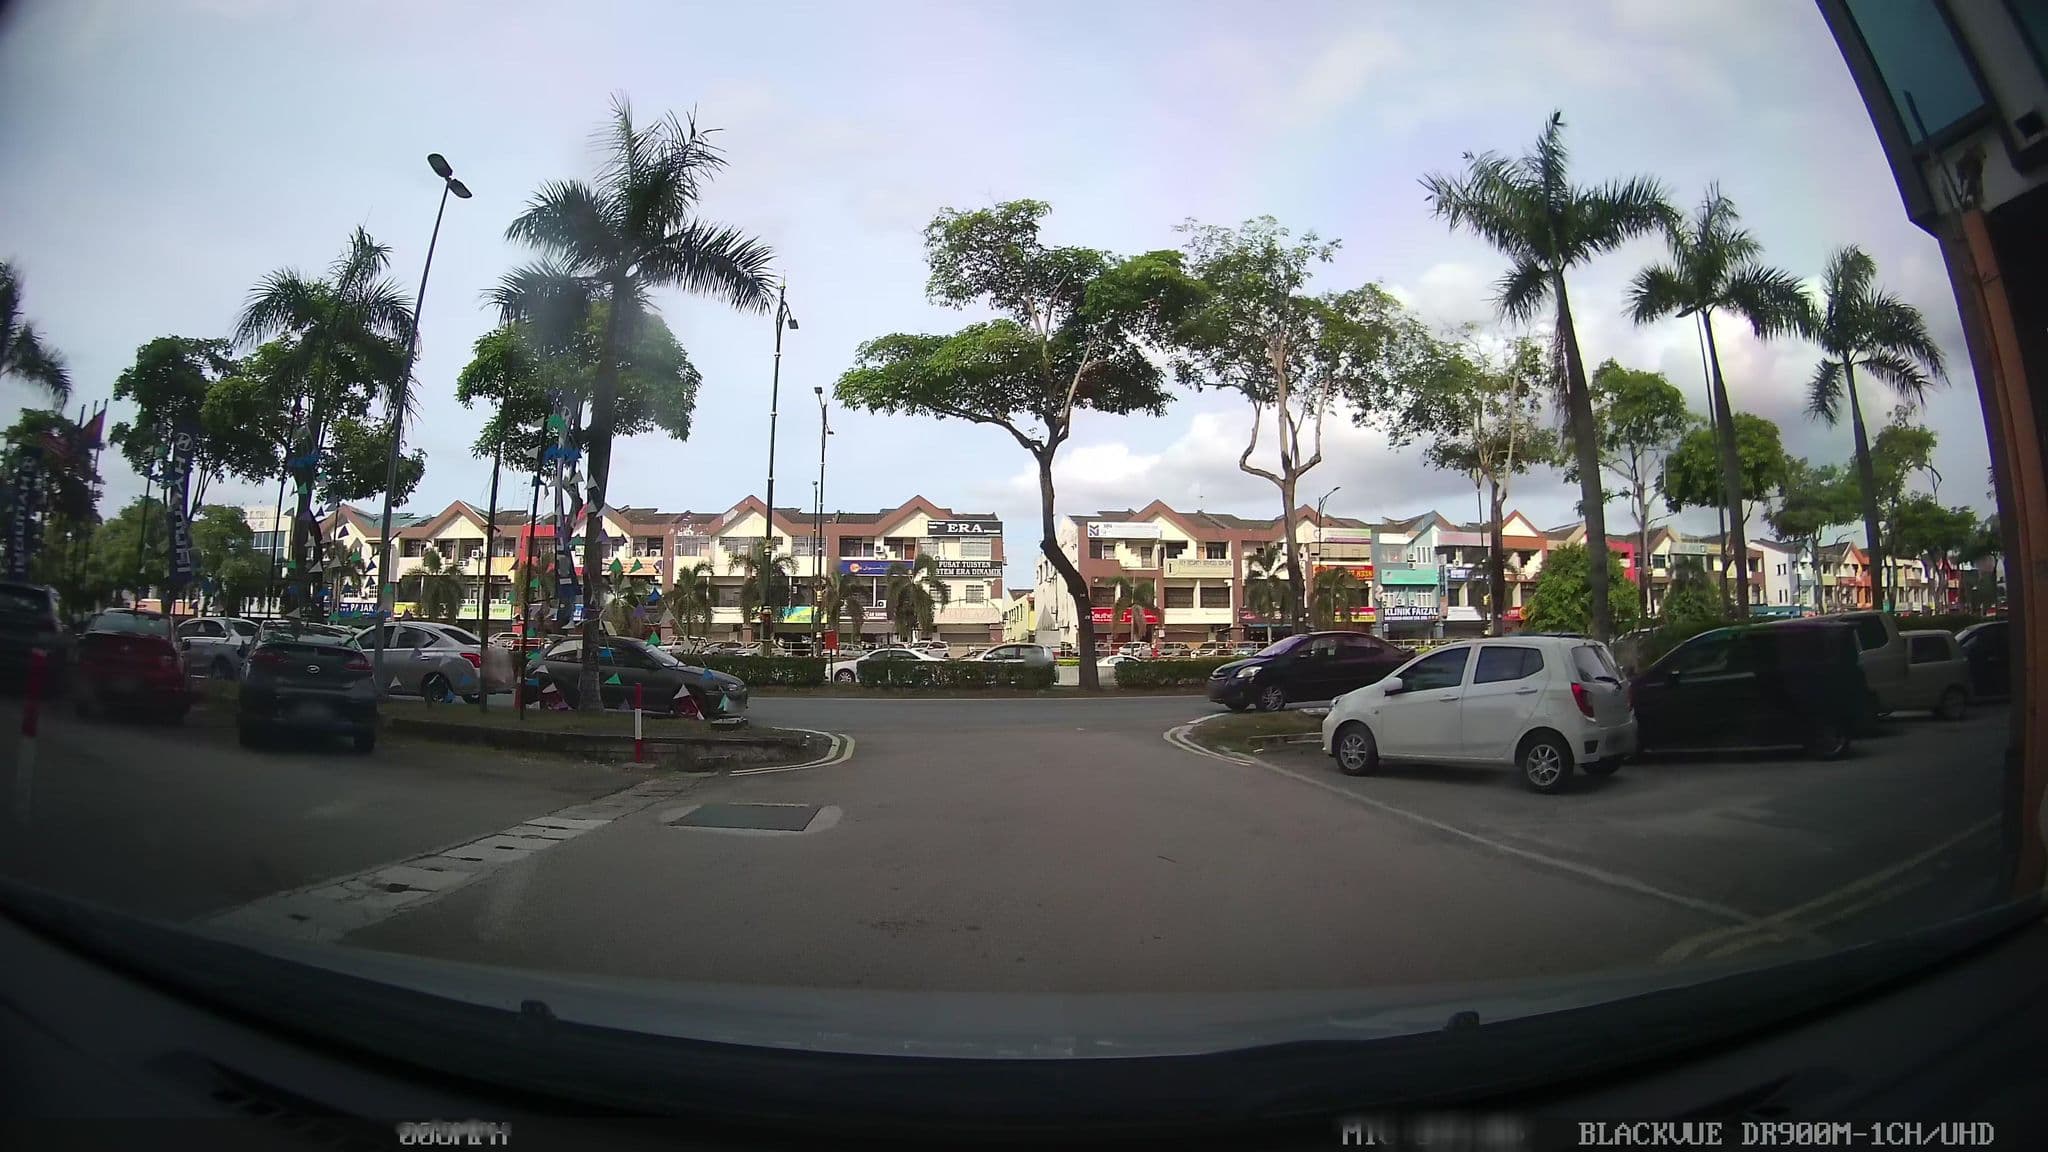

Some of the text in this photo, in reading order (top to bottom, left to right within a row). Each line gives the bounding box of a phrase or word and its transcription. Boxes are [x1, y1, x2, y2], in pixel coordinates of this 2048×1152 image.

[947, 523, 983, 533] ERA
[956, 568, 971, 576] ERA
[972, 568, 1002, 576] DINAMIK
[1384, 607, 1411, 616] KLINIK
[1411, 607, 1438, 616] FAIZAL
